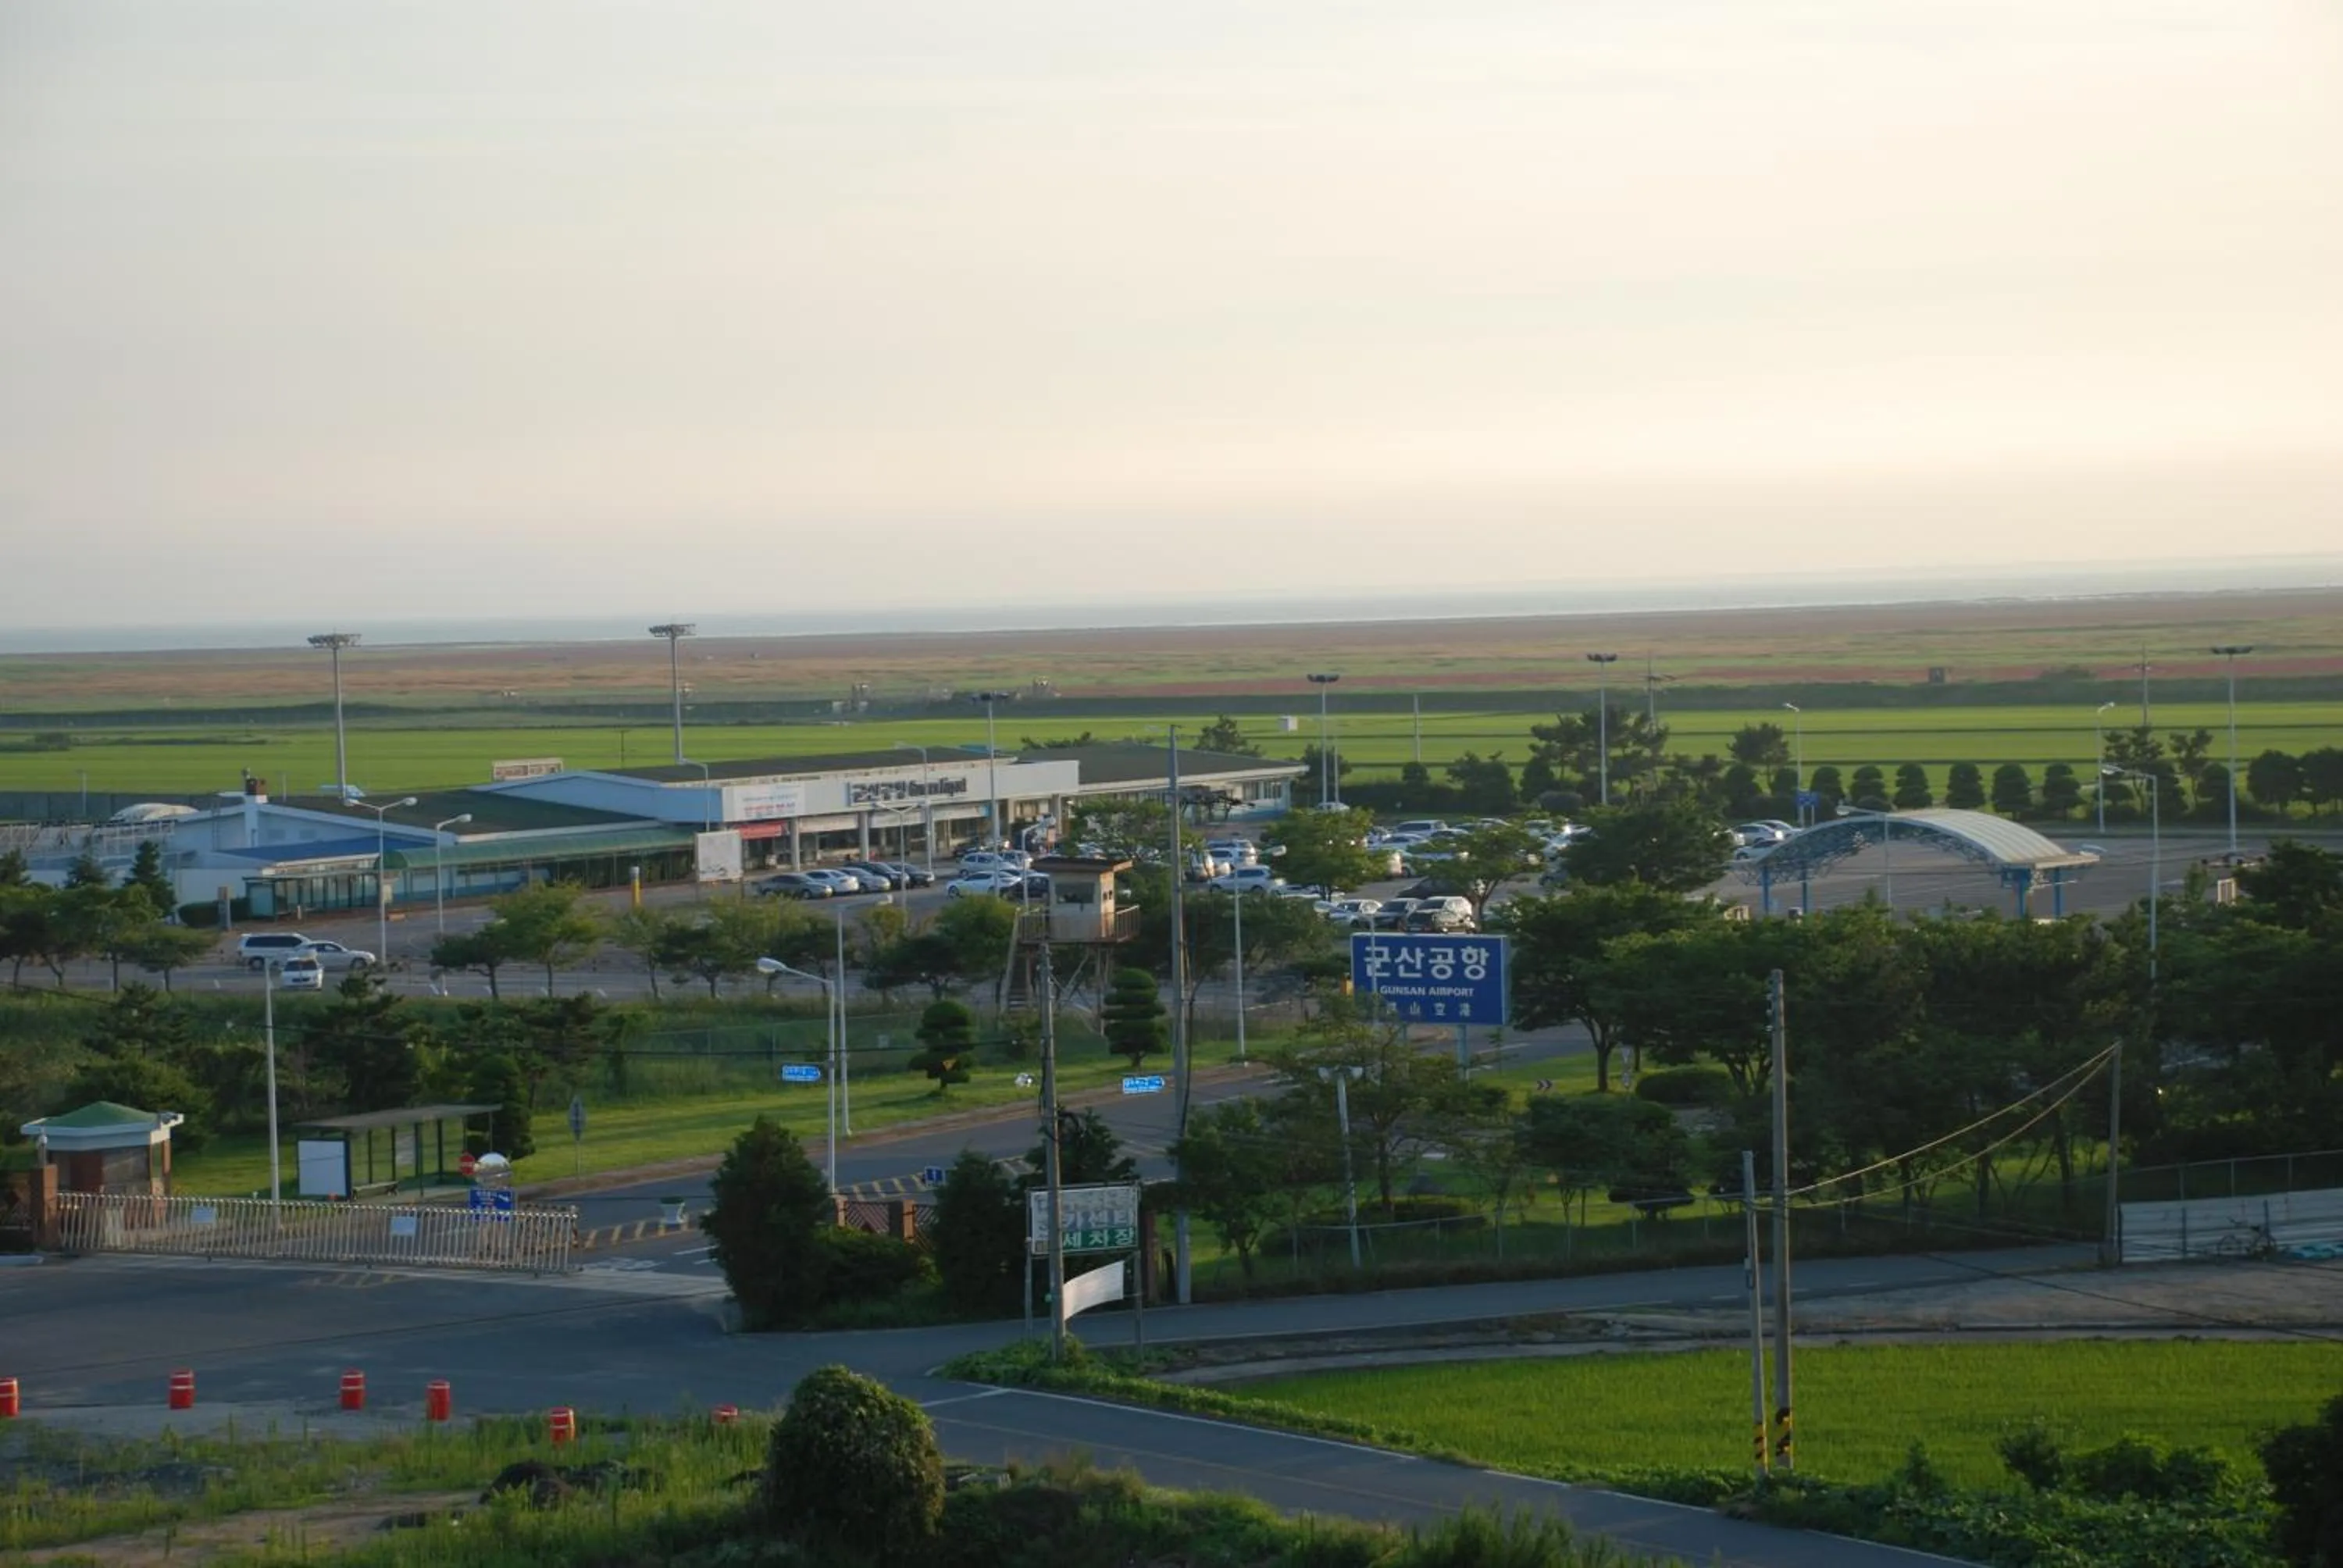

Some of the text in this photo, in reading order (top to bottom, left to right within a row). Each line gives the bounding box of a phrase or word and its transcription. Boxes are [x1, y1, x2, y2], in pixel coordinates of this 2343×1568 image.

[1364, 946, 1490, 981] 군산공항
[1380, 985, 1475, 997] GUNSAN AIRPORT
